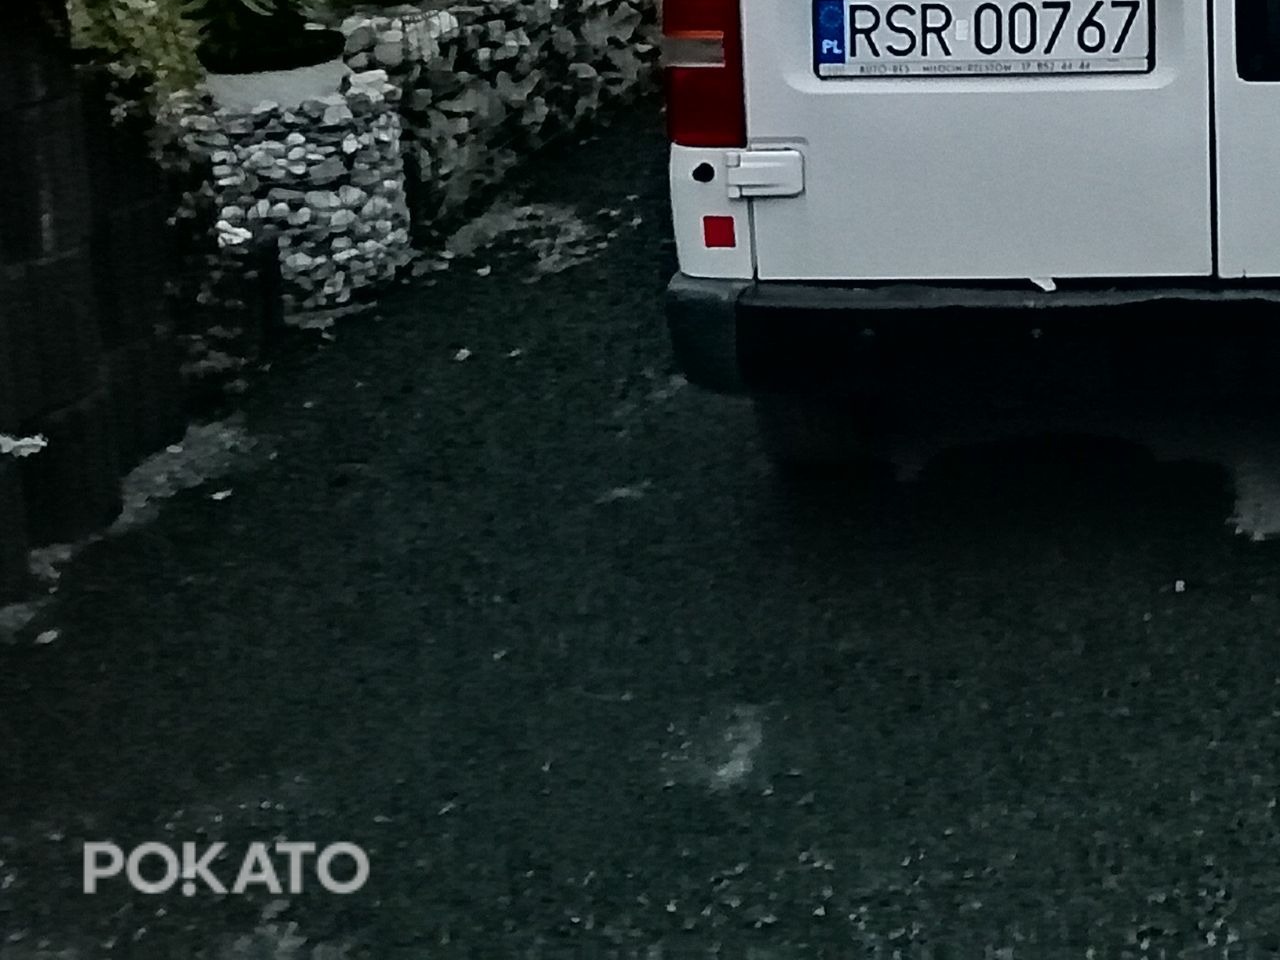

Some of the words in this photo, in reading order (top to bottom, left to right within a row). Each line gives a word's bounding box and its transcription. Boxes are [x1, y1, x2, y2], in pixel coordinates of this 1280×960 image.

[822, 39, 842, 54] PL
[849, 3, 952, 57] RSR
[973, 0, 1141, 55] 00767
